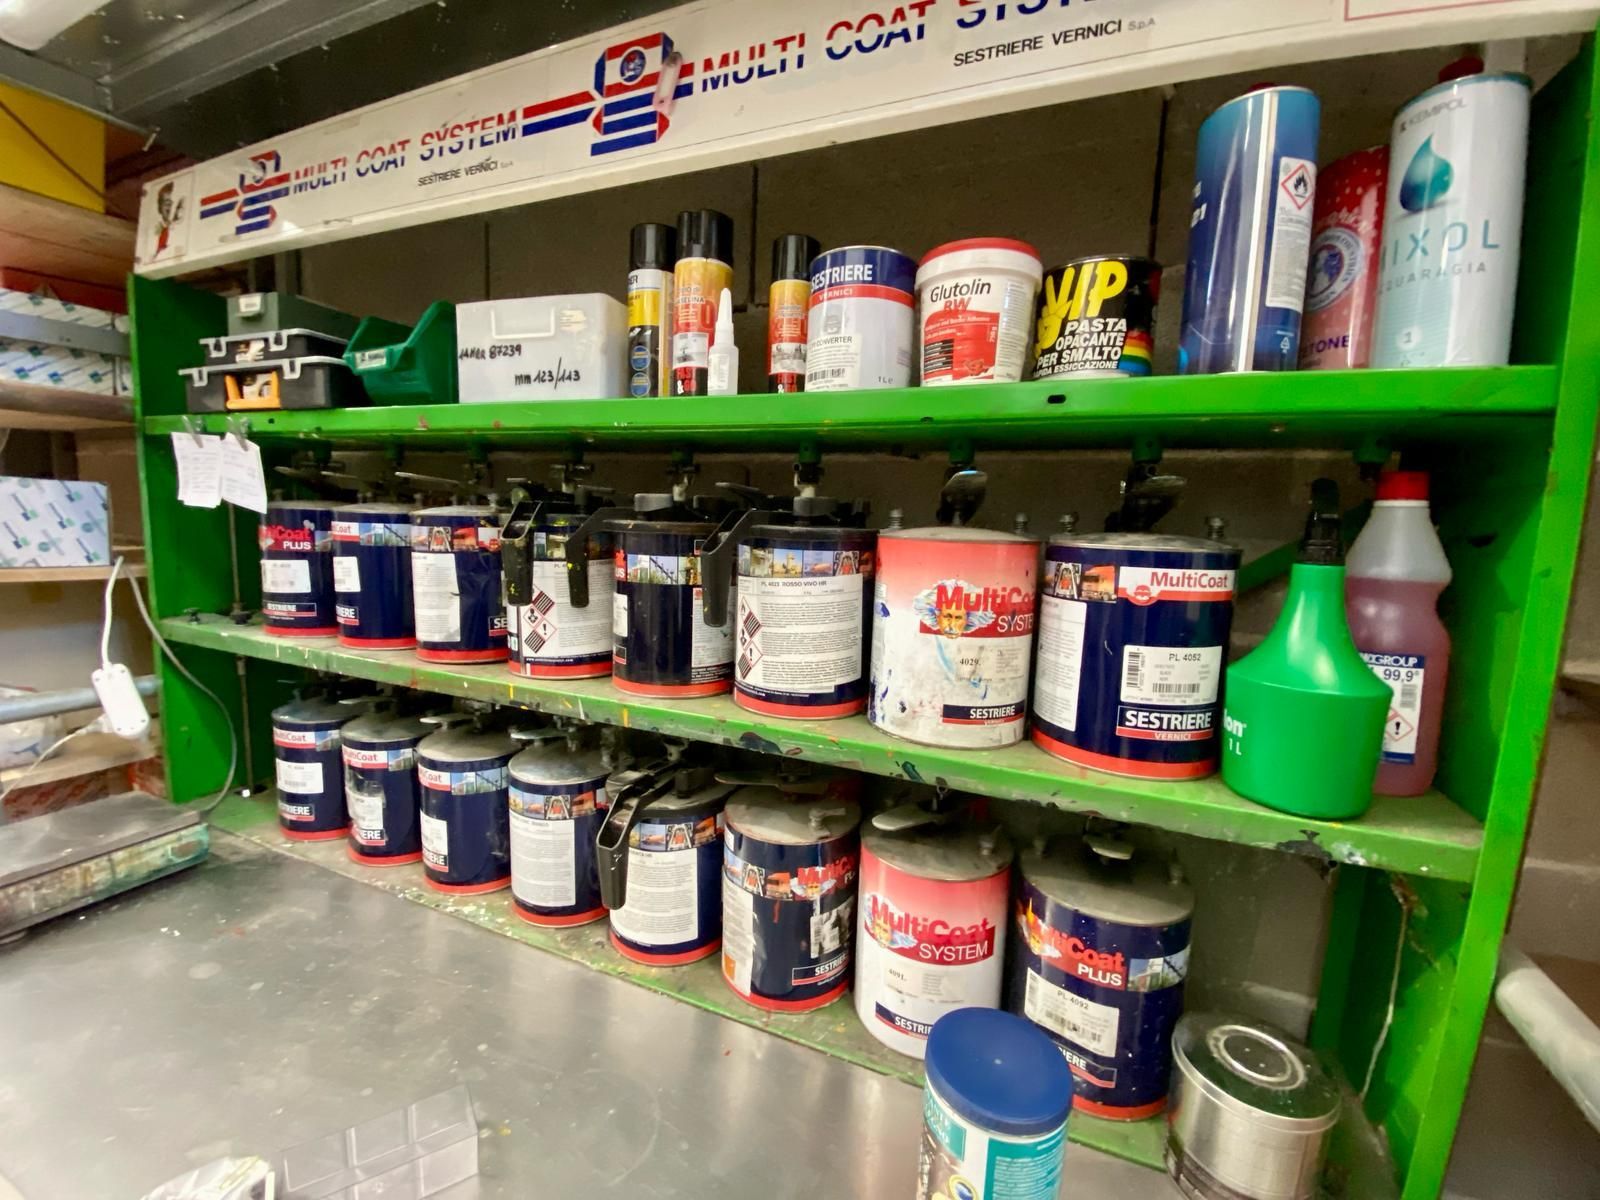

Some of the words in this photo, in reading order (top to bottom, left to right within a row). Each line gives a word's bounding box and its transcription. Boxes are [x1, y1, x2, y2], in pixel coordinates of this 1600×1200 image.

[702, 33, 805, 93] MULTI
[825, 0, 937, 60] COAT
[953, 36, 1044, 67] SESTRIERE
[1051, 19, 1122, 46] VERNICI
[293, 160, 347, 194] MULTI
[355, 140, 411, 178] COAT
[419, 110, 518, 161] SYSTEM
[417, 171, 462, 188] SESTRIERE
[463, 160, 499, 177] VERNICI
[811, 264, 873, 291] SESTRIERE
[930, 278, 992, 302] Glutolin
[1037, 260, 1128, 322] VIP
[1064, 318, 1128, 335] PASTA
[1055, 332, 1126, 352] OPACANTE
[1036, 352, 1059, 370] PER
[1061, 346, 1122, 364] SMALTO
[1054, 360, 1119, 374] ESSICCAZIONE
[283, 541, 312, 550] PLUS
[782, 580, 803, 588] ROSSO
[1150, 571, 1228, 589] MultiCoat
[997, 613, 1034, 633] SYSTE
[1169, 654, 1180, 662] PL
[1182, 653, 1202, 662] 4052
[969, 705, 1016, 719] SESTRIERE
[1125, 710, 1212, 730] SESTRIERE
[1153, 731, 1192, 742] VERNICI
[871, 894, 990, 944] MultiCoat
[918, 940, 989, 962] SYSTEM
[1077, 962, 1123, 987] PLUS
[1057, 991, 1067, 1001] PL
